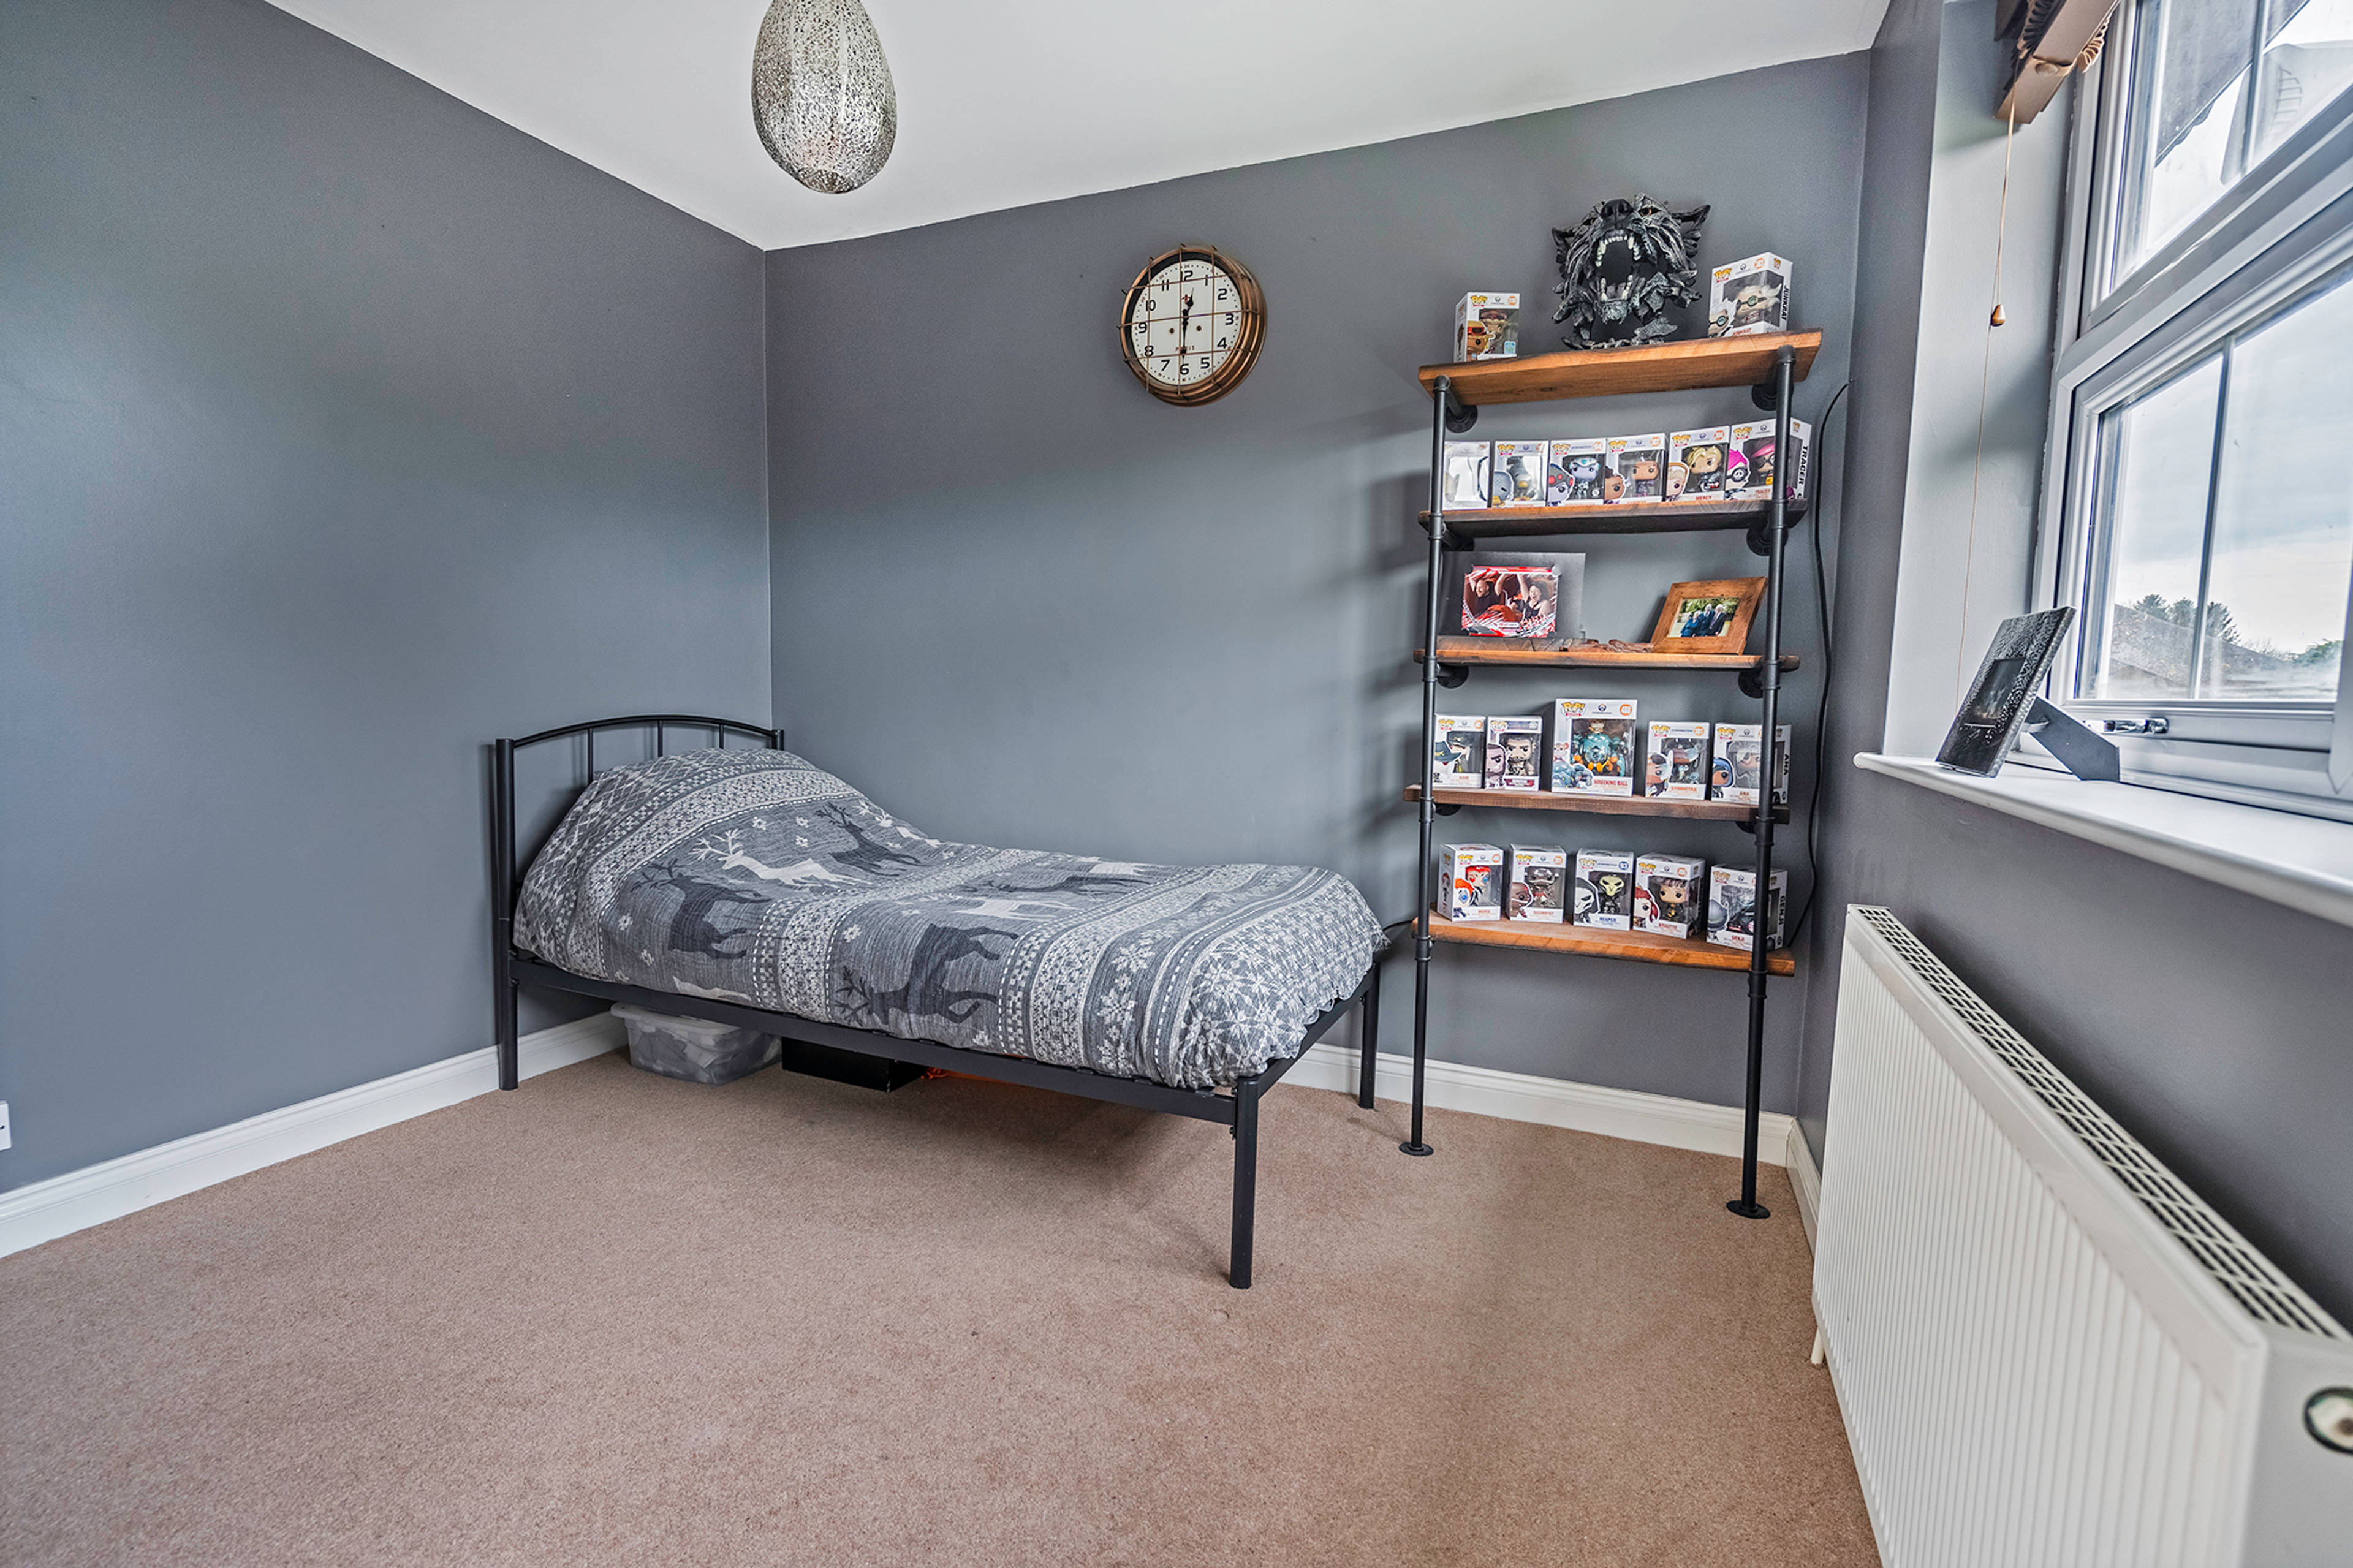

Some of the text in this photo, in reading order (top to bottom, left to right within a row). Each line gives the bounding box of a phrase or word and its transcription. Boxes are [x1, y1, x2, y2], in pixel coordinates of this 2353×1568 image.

[1180, 270, 1193, 282] 12
[1162, 279, 1169, 291] 11
[1218, 288, 1227, 300] 2
[1146, 300, 1156, 311] 10
[1225, 312, 1234, 325] 3
[1139, 322, 1147, 333] 9
[1217, 337, 1227, 349] 4
[1145, 345, 1154, 357] 8
[1161, 359, 1170, 371] 7
[1180, 363, 1189, 375] 6
[1200, 357, 1210, 369] 5
[1799, 446, 1808, 485] TRACER
